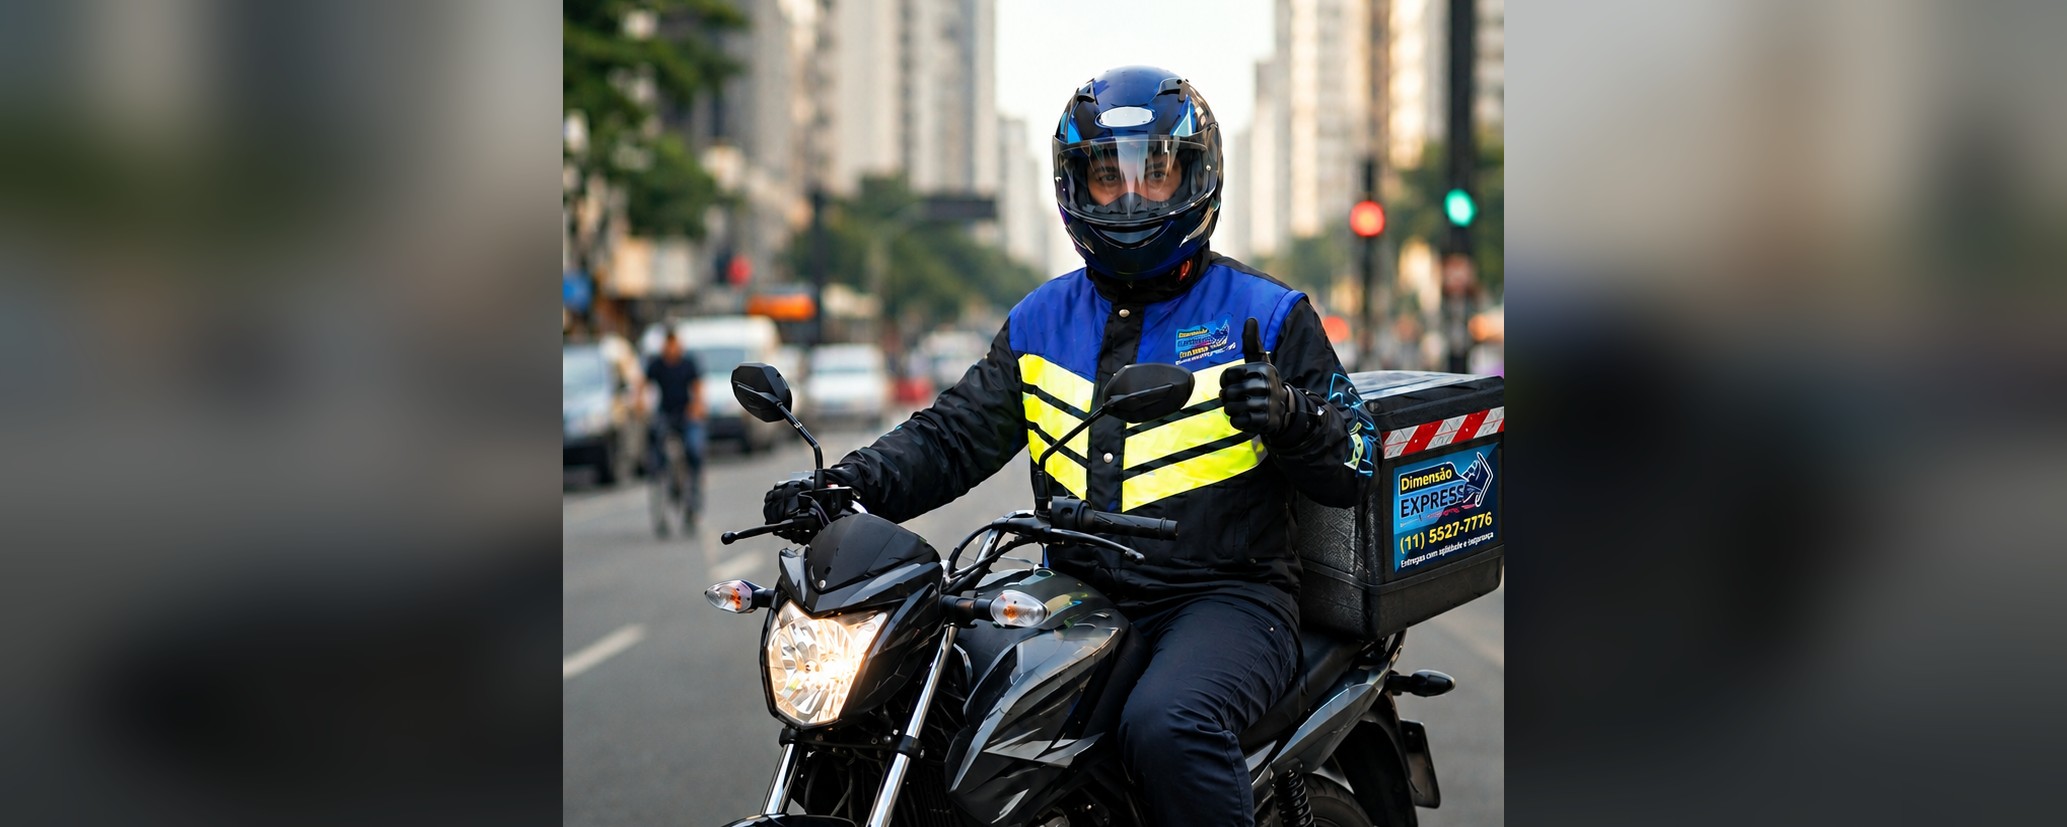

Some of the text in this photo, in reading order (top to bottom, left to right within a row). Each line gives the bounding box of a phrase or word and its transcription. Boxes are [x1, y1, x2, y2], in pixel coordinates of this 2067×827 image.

[1401, 467, 1453, 491] Dimensão
[1401, 484, 1464, 518] EXPRESS
[1400, 511, 1493, 554] (11) 5527-7776
